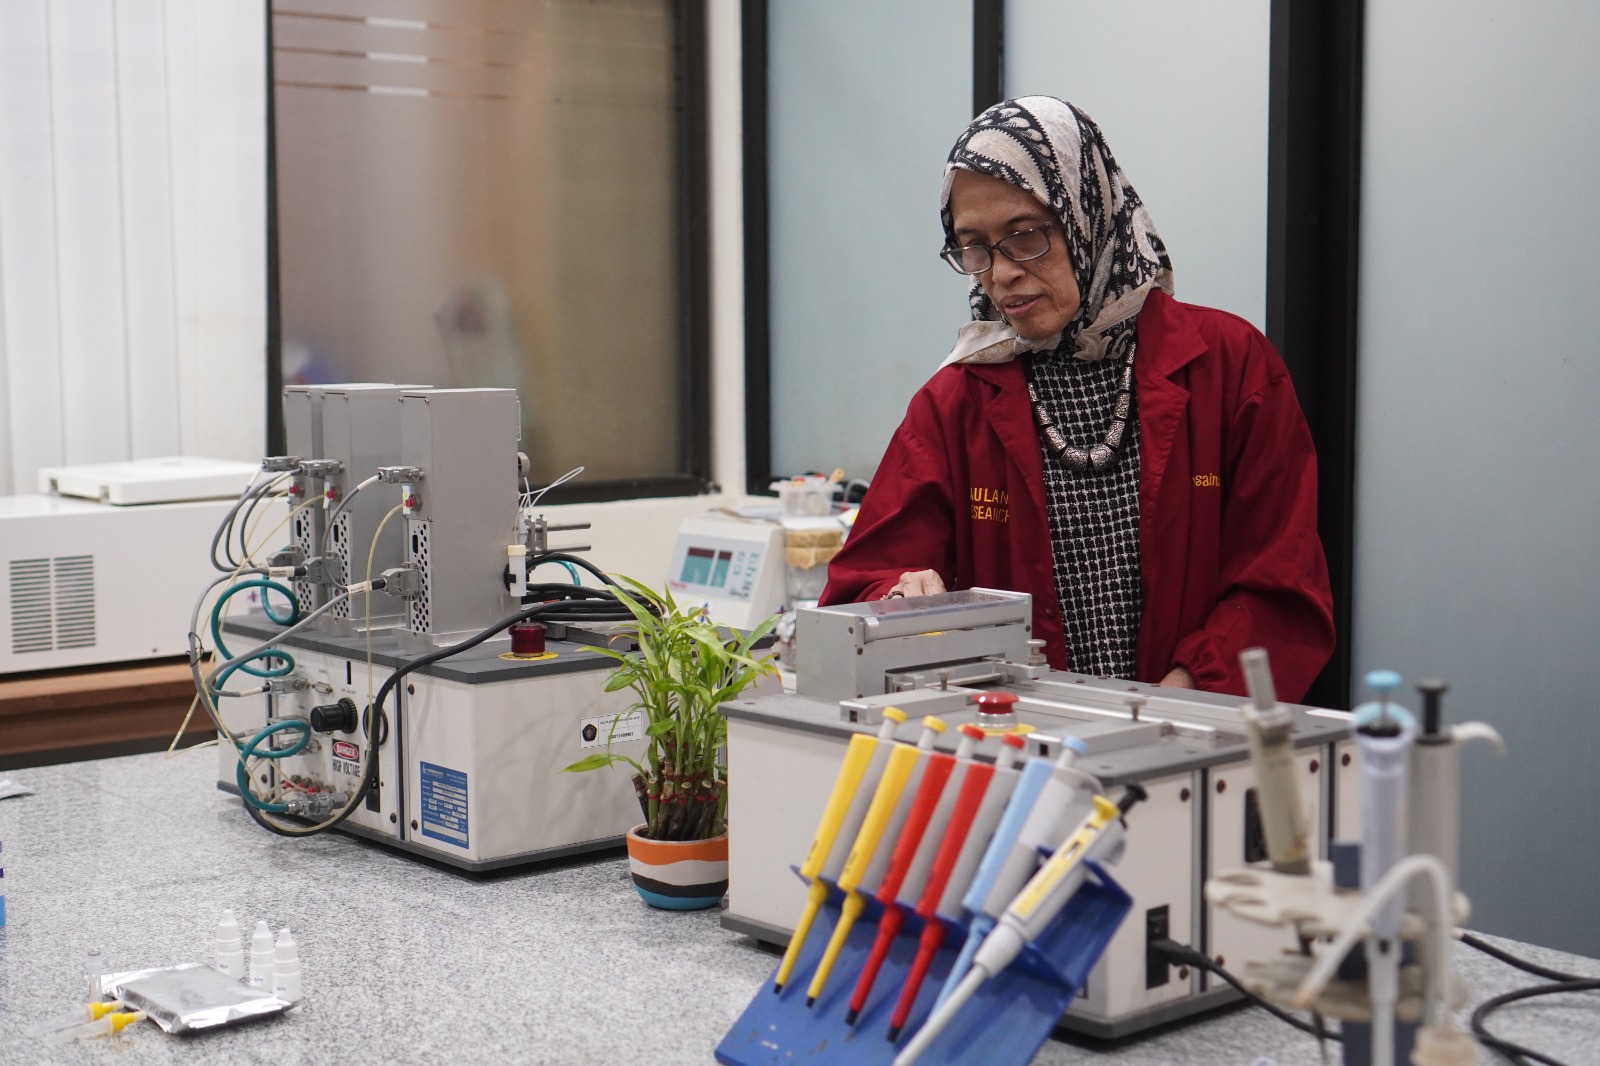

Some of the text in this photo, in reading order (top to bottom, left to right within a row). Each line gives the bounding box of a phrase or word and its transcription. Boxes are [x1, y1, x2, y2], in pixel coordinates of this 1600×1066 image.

[1192, 472, 1220, 487] sain
[336, 743, 357, 758] DANGER
[332, 758, 361, 778] HIGH VOLTAGE
